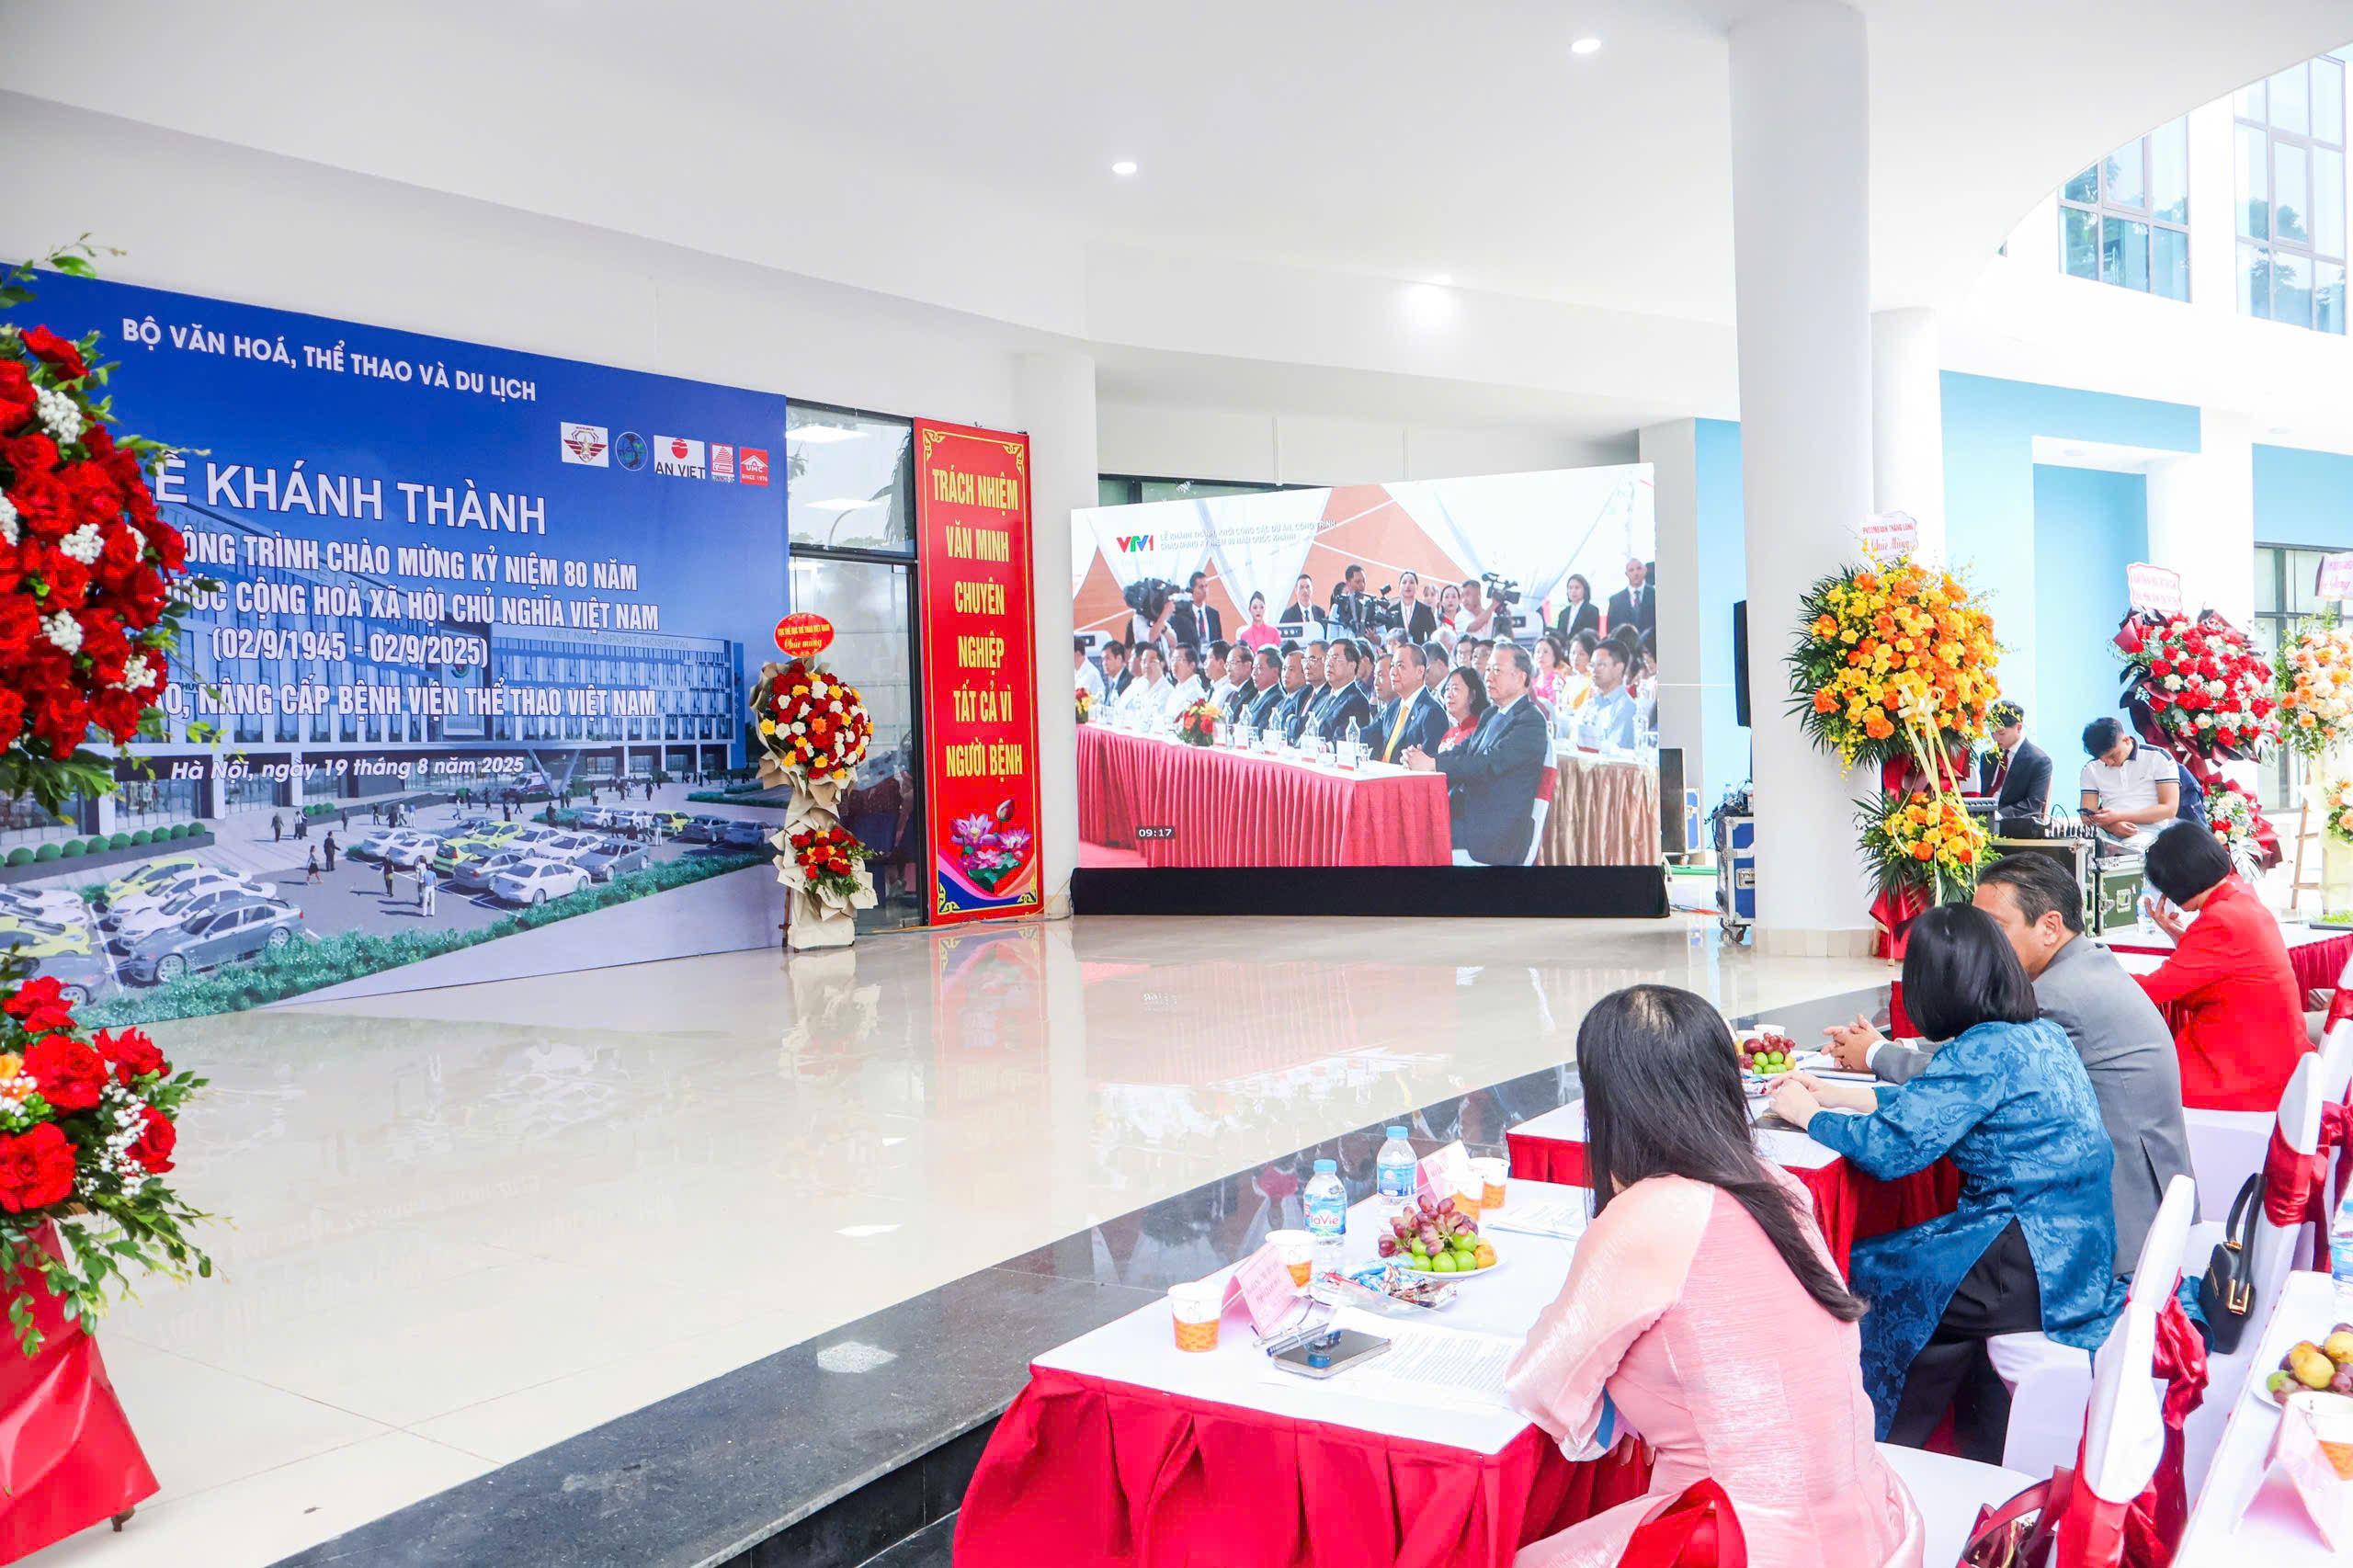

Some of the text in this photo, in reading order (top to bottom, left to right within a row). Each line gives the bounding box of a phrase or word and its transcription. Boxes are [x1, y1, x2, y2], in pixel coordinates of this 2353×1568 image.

[122, 315, 537, 403] BỘ VĂN HOÁ, THỂ THAO VÀ DU LỊCH
[154, 449, 547, 535] Ễ KHÁNH THÀNH
[655, 461, 674, 476] AN
[678, 465, 706, 480] VIET
[932, 464, 1018, 516] TRÁCH NHIỆM
[183, 524, 236, 565] ÔNG
[243, 530, 319, 570] TRÌNH
[326, 537, 391, 574] CHÀO
[397, 542, 465, 580] MỪNG
[472, 545, 498, 582] KỶ
[506, 551, 558, 590] NIỆM
[563, 560, 587, 588] 80
[593, 558, 638, 590] NĂM
[946, 520, 1009, 562] VĂN MINH
[1117, 535, 1154, 553] VTV1
[165, 573, 228, 611] ƯỚC
[235, 576, 306, 620] CỘNG
[313, 581, 363, 618] HOÀ
[369, 584, 403, 620] XÃ
[407, 586, 446, 627] HỘI
[452, 587, 495, 623] CHỦ
[502, 595, 565, 627] NGHĨA
[570, 597, 610, 634] VIỆT
[616, 603, 660, 631] NAM
[955, 577, 1005, 615] CHUYÊN
[212, 627, 347, 662] (02/9/1945
[370, 633, 488, 669] 02/9/2025)
[958, 631, 1005, 676] NGHIỆP
[199, 676, 273, 715] NÂNG
[280, 674, 330, 715] CẤP
[338, 678, 401, 722] BỆNH
[408, 681, 458, 722] VIỆN
[465, 677, 505, 716] THỂ
[511, 687, 561, 716] THAO
[567, 685, 609, 722] VIỆT
[613, 689, 656, 717] NAM
[953, 679, 1012, 722] TẤT CẢ VÌ
[171, 756, 525, 784] Hà Nội, ngày 19 tháng 8 năm 2025
[946, 737, 1022, 782] NGƯỜI BỆNH
[1138, 828, 1173, 837] 09:17
